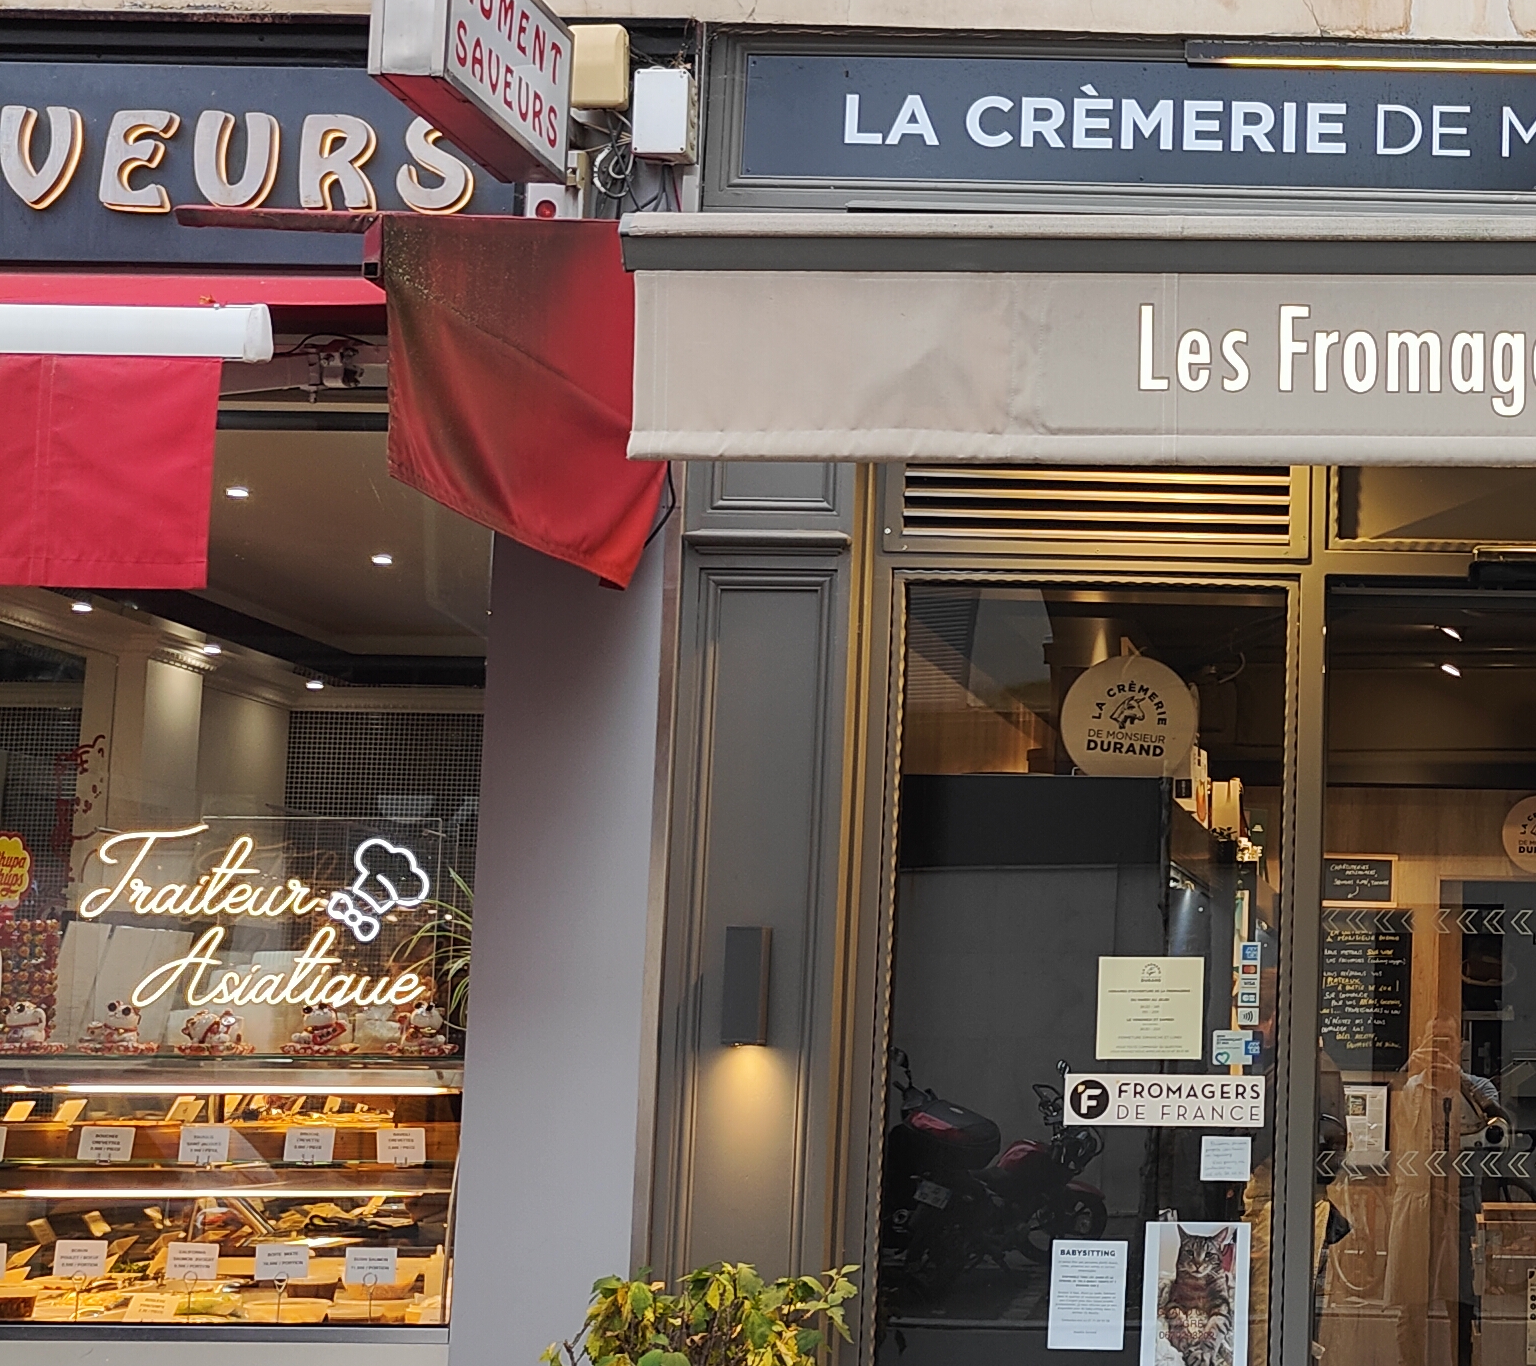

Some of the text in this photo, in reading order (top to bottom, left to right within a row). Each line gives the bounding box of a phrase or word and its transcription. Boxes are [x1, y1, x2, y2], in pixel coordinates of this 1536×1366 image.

[456, 20, 558, 149] SAVEURS
[843, 93, 939, 146] LA
[965, 83, 1347, 155] CRÈMERIE
[1375, 103, 1472, 158] DE
[1137, 302, 1250, 393] Les
[1092, 680, 1167, 726] LA CRÈMERIE
[1086, 739, 1165, 757] DURAND
[1088, 729, 1166, 744] DE MONSIEUR
[1519, 823, 1528, 835] LA
[79, 824, 320, 919] Traiteur
[131, 926, 426, 1007] Asiatique
[1118, 1082, 1261, 1099] FROMAGERS
[1116, 1105, 1261, 1121] DE FRANCE
[1060, 1249, 1116, 1257] BABYSITTING
